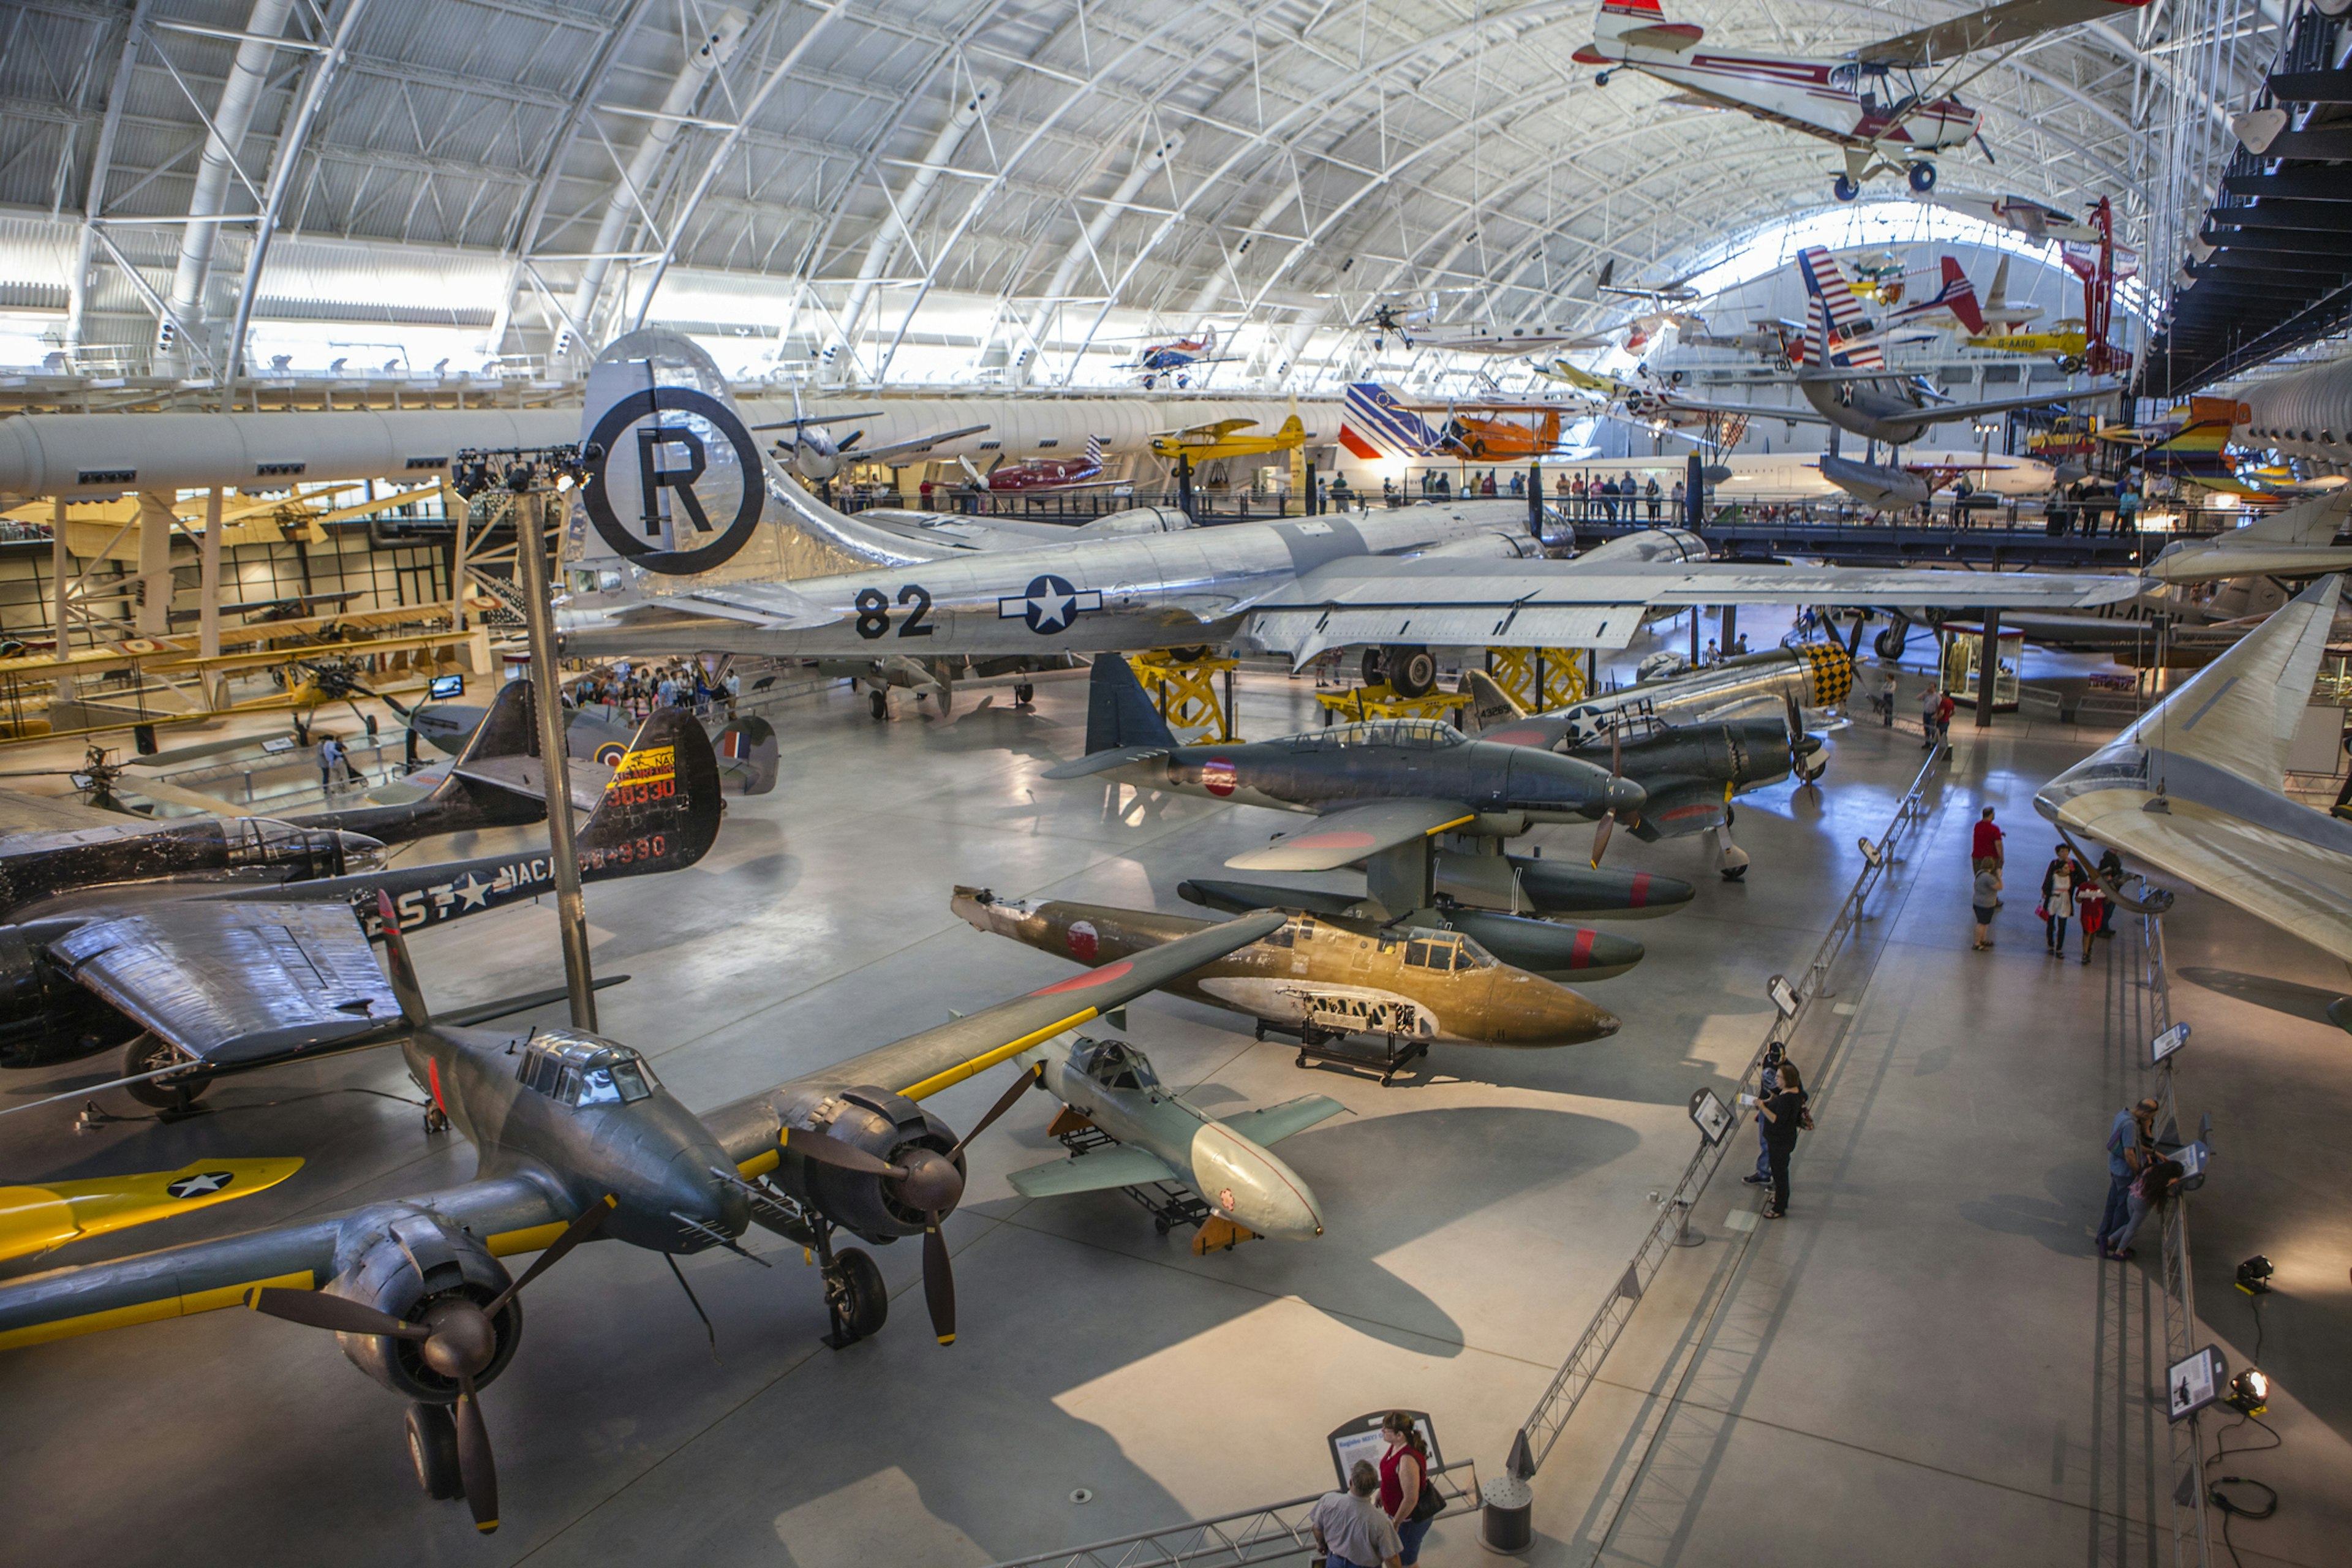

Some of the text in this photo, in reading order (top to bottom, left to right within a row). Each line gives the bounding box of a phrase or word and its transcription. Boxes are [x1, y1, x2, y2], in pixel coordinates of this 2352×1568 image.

[638, 427, 713, 535] R
[855, 584, 933, 639] 82
[499, 857, 555, 887] NAC
